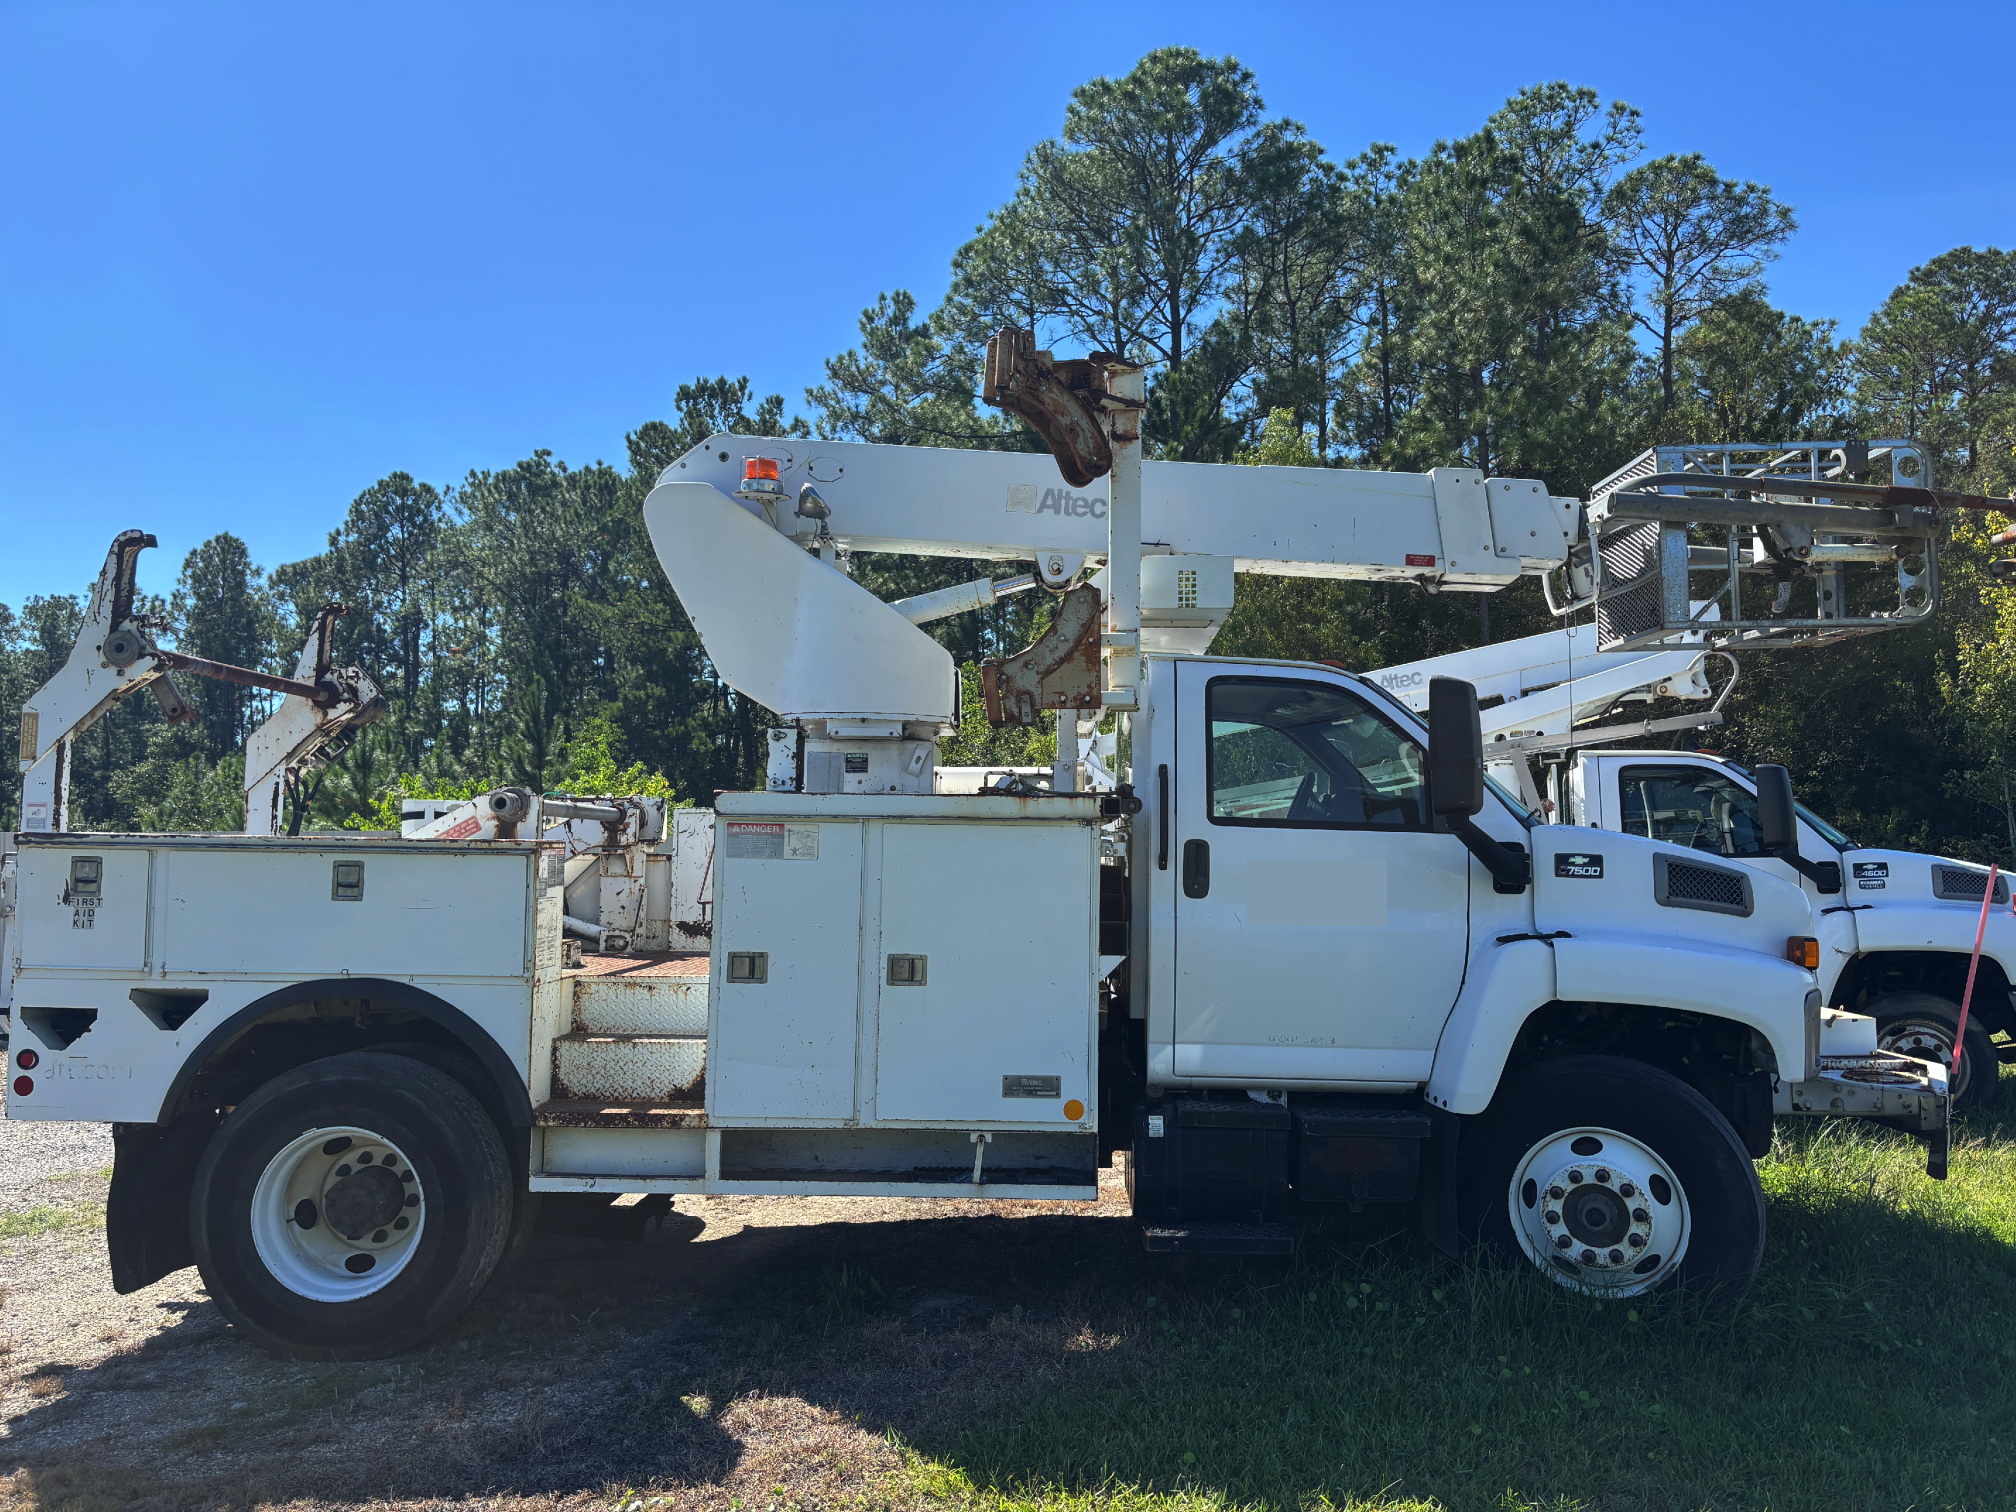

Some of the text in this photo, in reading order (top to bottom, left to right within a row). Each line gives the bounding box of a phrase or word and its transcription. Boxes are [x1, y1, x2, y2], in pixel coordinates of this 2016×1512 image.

[1037, 487, 1107, 519] Altec
[1380, 671, 1423, 690] Altec
[741, 824, 780, 833] DANGER
[1558, 866, 1601, 876] C7500
[68, 897, 103, 907] FIRST
[74, 908, 95, 918] AID
[72, 919, 94, 929] KIT
